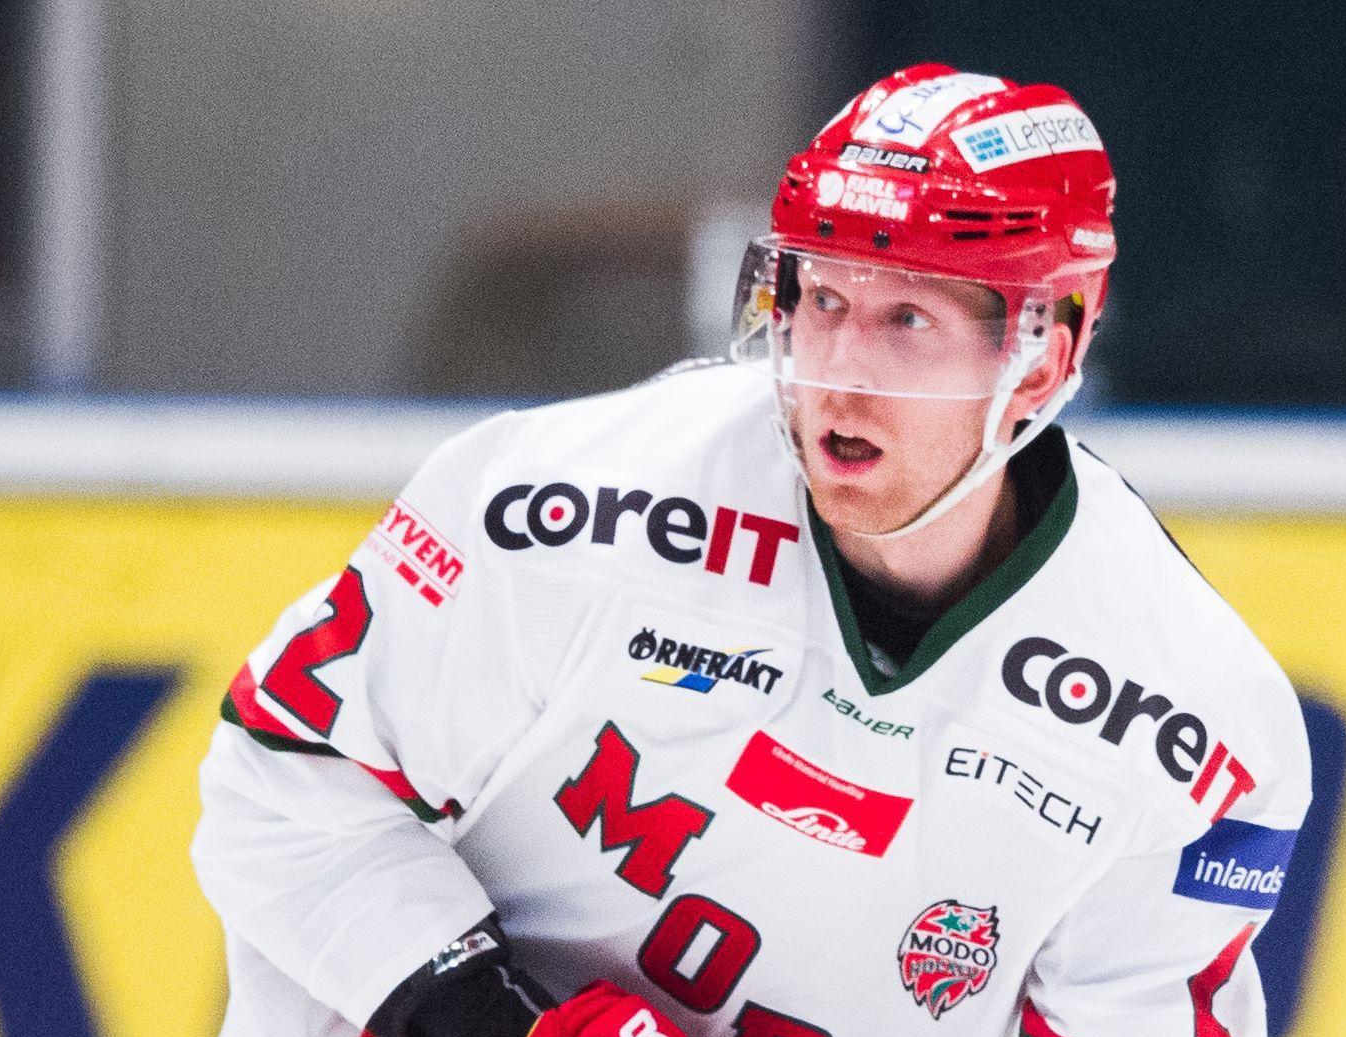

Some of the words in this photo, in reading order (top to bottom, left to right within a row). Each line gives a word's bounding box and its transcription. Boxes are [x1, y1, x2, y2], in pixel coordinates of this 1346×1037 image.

[484, 482, 799, 586] coreIT
[1002, 636, 1257, 826] coreIT
[761, 801, 867, 852] Linde
[910, 932, 990, 966] MODO
